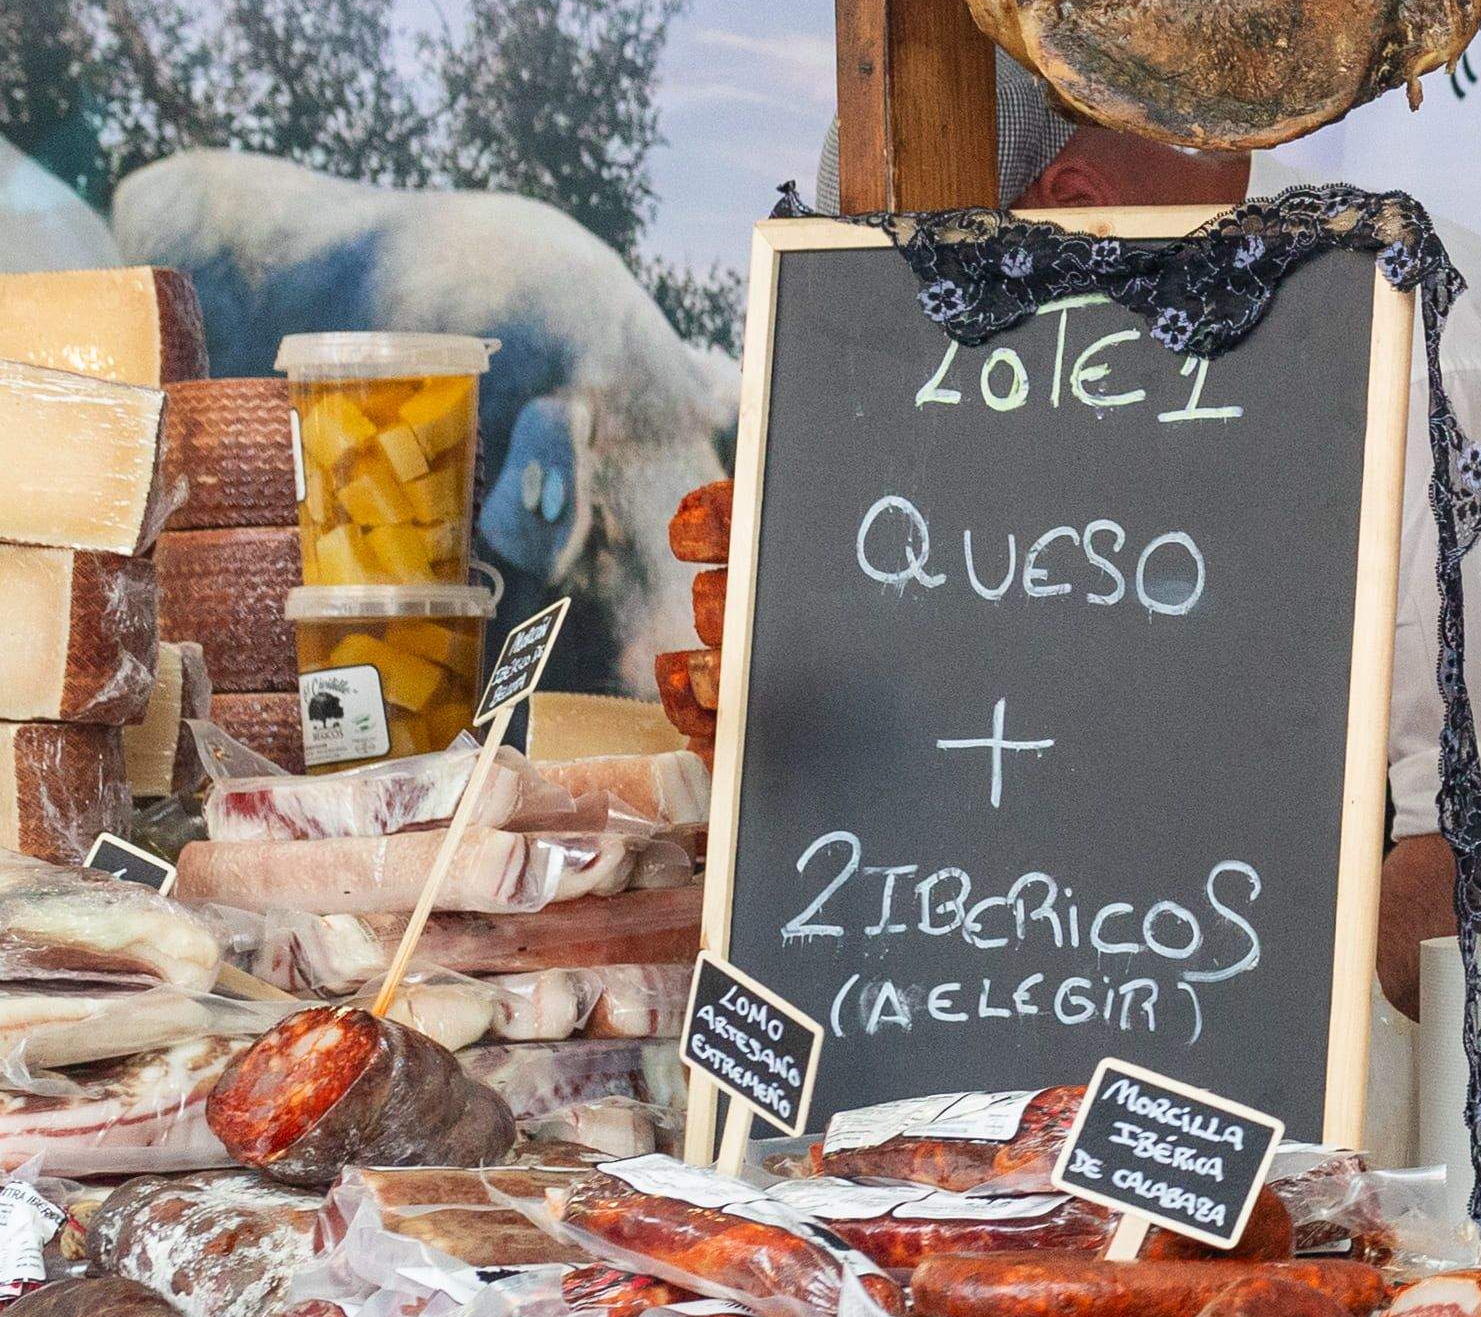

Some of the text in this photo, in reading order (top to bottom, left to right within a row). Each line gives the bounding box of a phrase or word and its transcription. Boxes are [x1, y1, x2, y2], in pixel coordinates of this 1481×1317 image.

[914, 293, 1243, 424] LOTE 1
[856, 494, 1208, 617] QUESO
[935, 697, 1055, 808] +
[719, 985, 783, 1041] LOMO
[692, 1034, 791, 1118] EXTREMEÑO
[1102, 1079, 1244, 1151] MORCILLA
[1069, 1148, 1103, 1179] DE
[1111, 1169, 1226, 1227] CALABAZA
[1108, 1121, 1224, 1182] IBÉRICA
